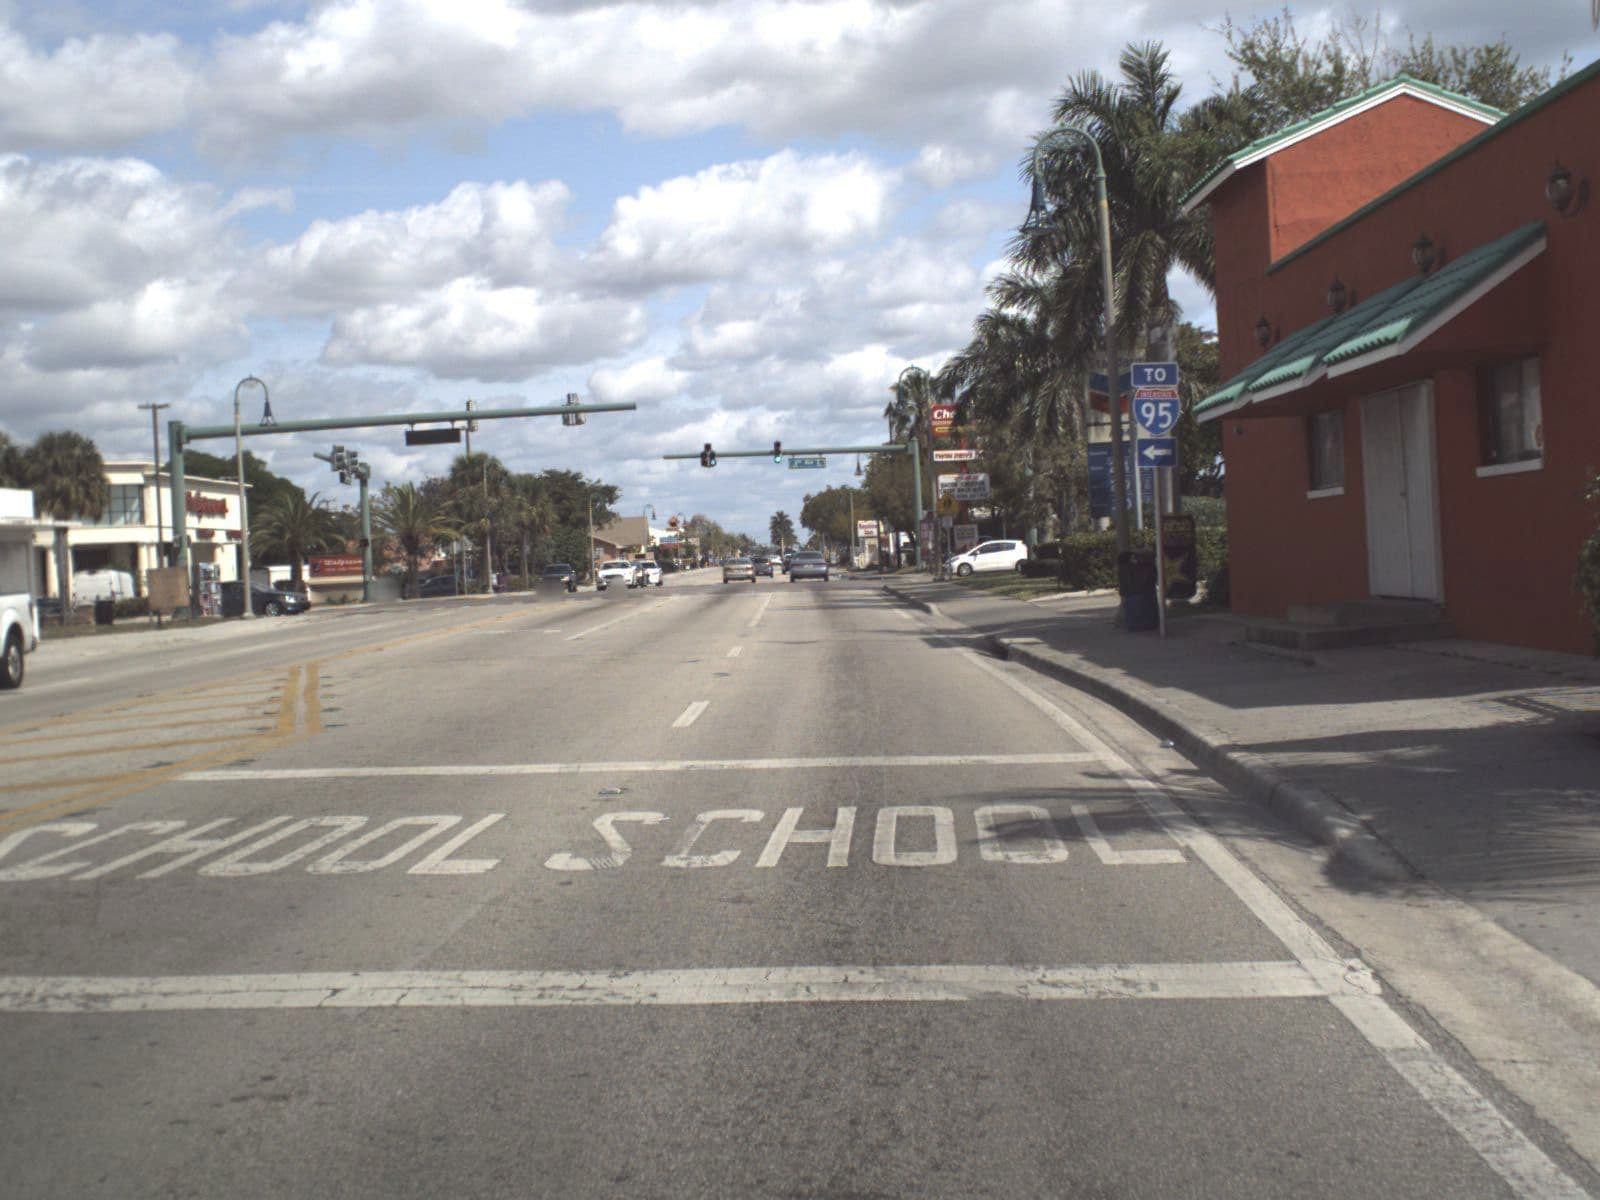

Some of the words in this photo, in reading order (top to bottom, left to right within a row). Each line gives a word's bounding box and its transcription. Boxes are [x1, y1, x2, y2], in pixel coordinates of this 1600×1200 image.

[1143, 367, 1167, 382] TO
[1141, 402, 1173, 429] 95
[544, 804, 1187, 869] SCHOOL
